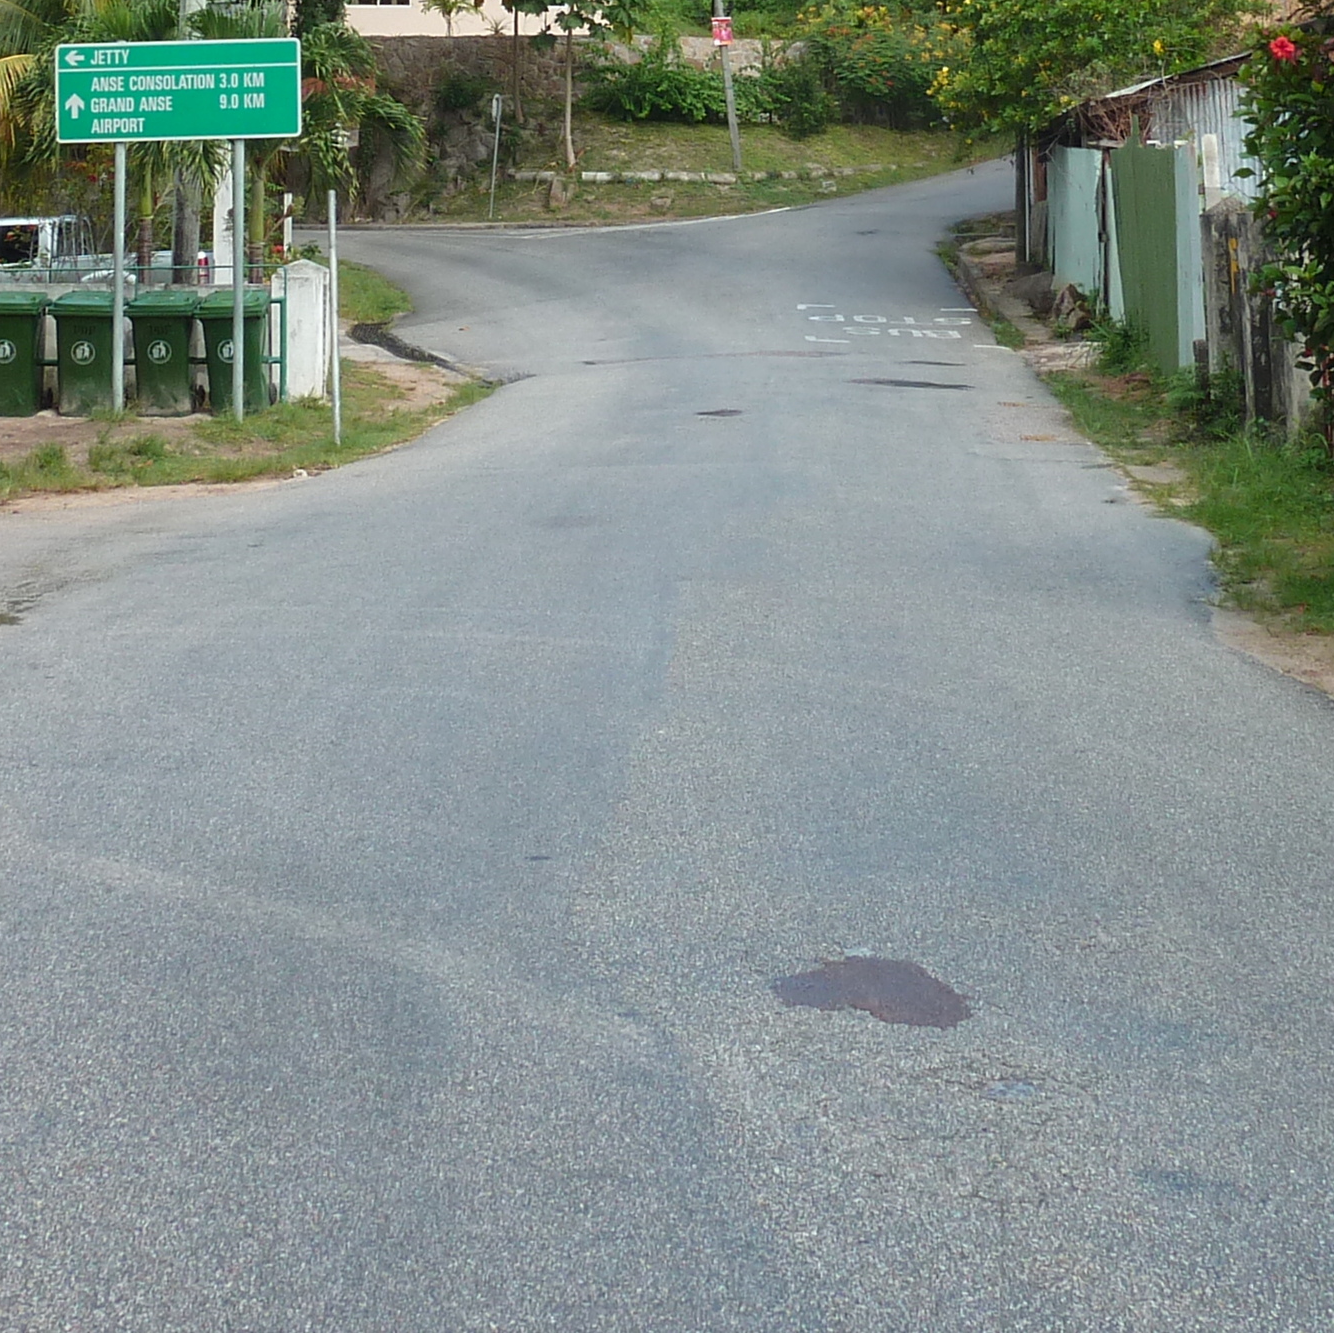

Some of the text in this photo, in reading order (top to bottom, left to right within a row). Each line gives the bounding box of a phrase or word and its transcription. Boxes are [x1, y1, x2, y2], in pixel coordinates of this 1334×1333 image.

[90, 49, 130, 65] JETTY
[91, 72, 265, 92] ANSE CONSOLATION 3.0 KM
[91, 93, 265, 113] GRAND ANSE 9.0 KM
[91, 118, 145, 134] AIRPORT
[808, 314, 972, 325] STOP
[843, 326, 961, 339] BUS
